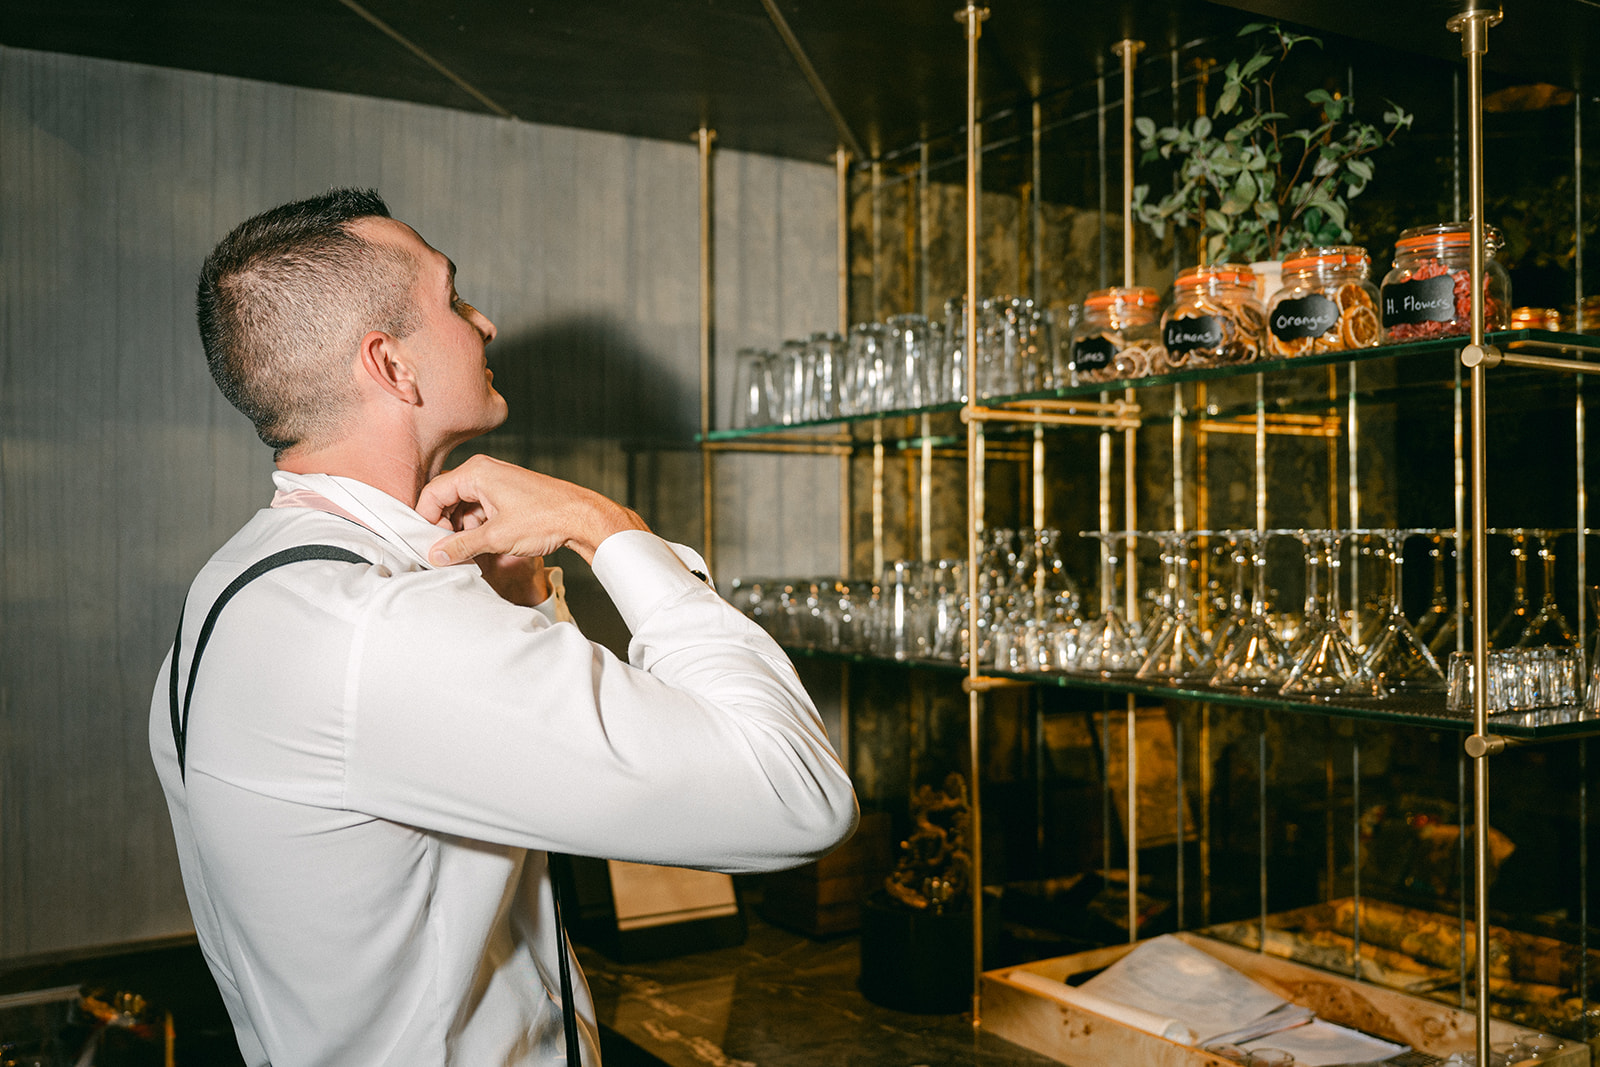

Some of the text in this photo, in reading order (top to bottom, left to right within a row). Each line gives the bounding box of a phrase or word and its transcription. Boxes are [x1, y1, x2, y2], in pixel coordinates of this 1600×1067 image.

[1386, 295, 1451, 315] H. Flowers
[1168, 328, 1212, 345] Lemons
